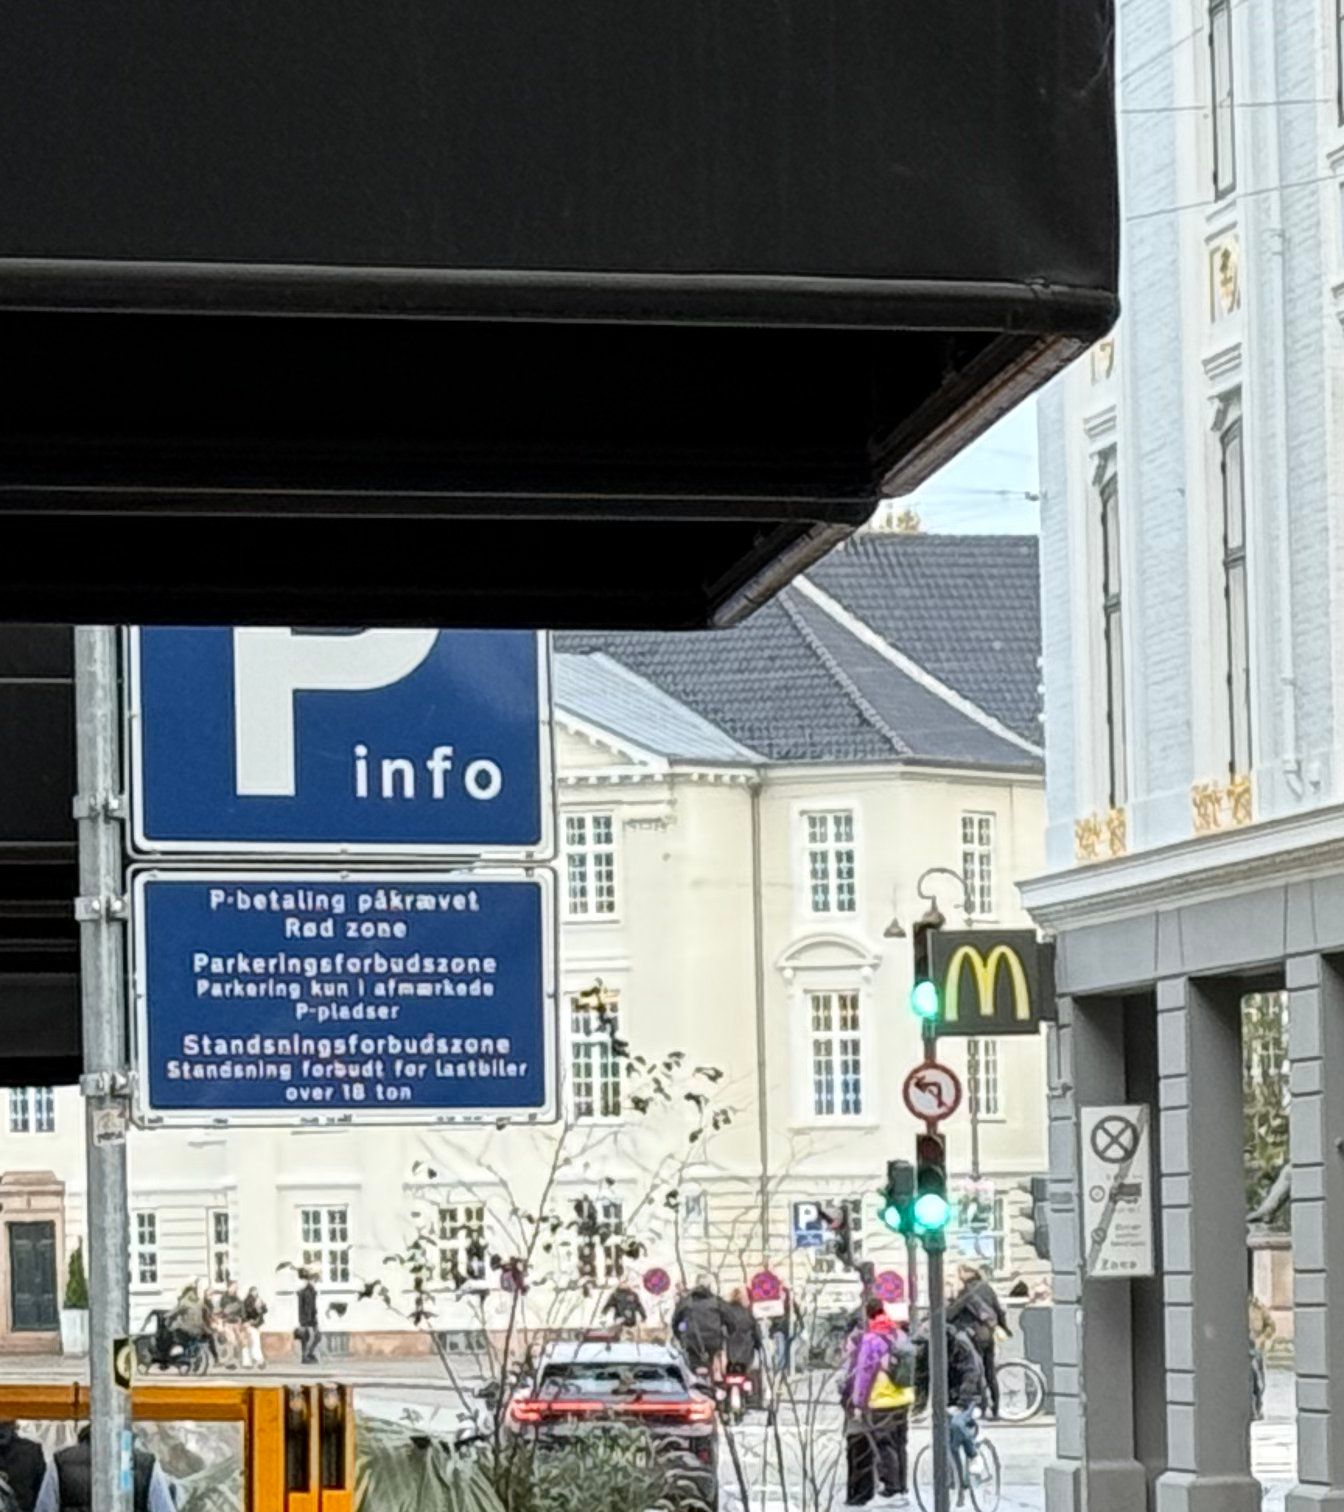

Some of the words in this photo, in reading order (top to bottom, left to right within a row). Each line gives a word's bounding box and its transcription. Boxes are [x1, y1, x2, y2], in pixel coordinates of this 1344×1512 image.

[233, 626, 440, 796] P
[354, 744, 502, 800] info
[209, 888, 345, 914] P-betaling
[357, 888, 479, 912] påkrævet
[284, 917, 334, 938] Rød
[345, 921, 407, 938] zone
[193, 952, 497, 978] Parkeringsforbudszone
[196, 978, 301, 999] Parkering
[309, 978, 348, 996] kun
[373, 978, 494, 996] afmærkede
[295, 1002, 399, 1022] P-pladser
[182, 1033, 510, 1057] Standsningsforbudszone
[166, 1059, 292, 1081] Standsning
[301, 1059, 384, 1078] forbudt
[393, 1058, 427, 1077] for
[434, 1057, 527, 1077] lastbiler
[284, 1086, 334, 1101] over
[341, 1082, 365, 1101] 18
[375, 1083, 411, 1100] ton
[798, 1204, 818, 1231] P
